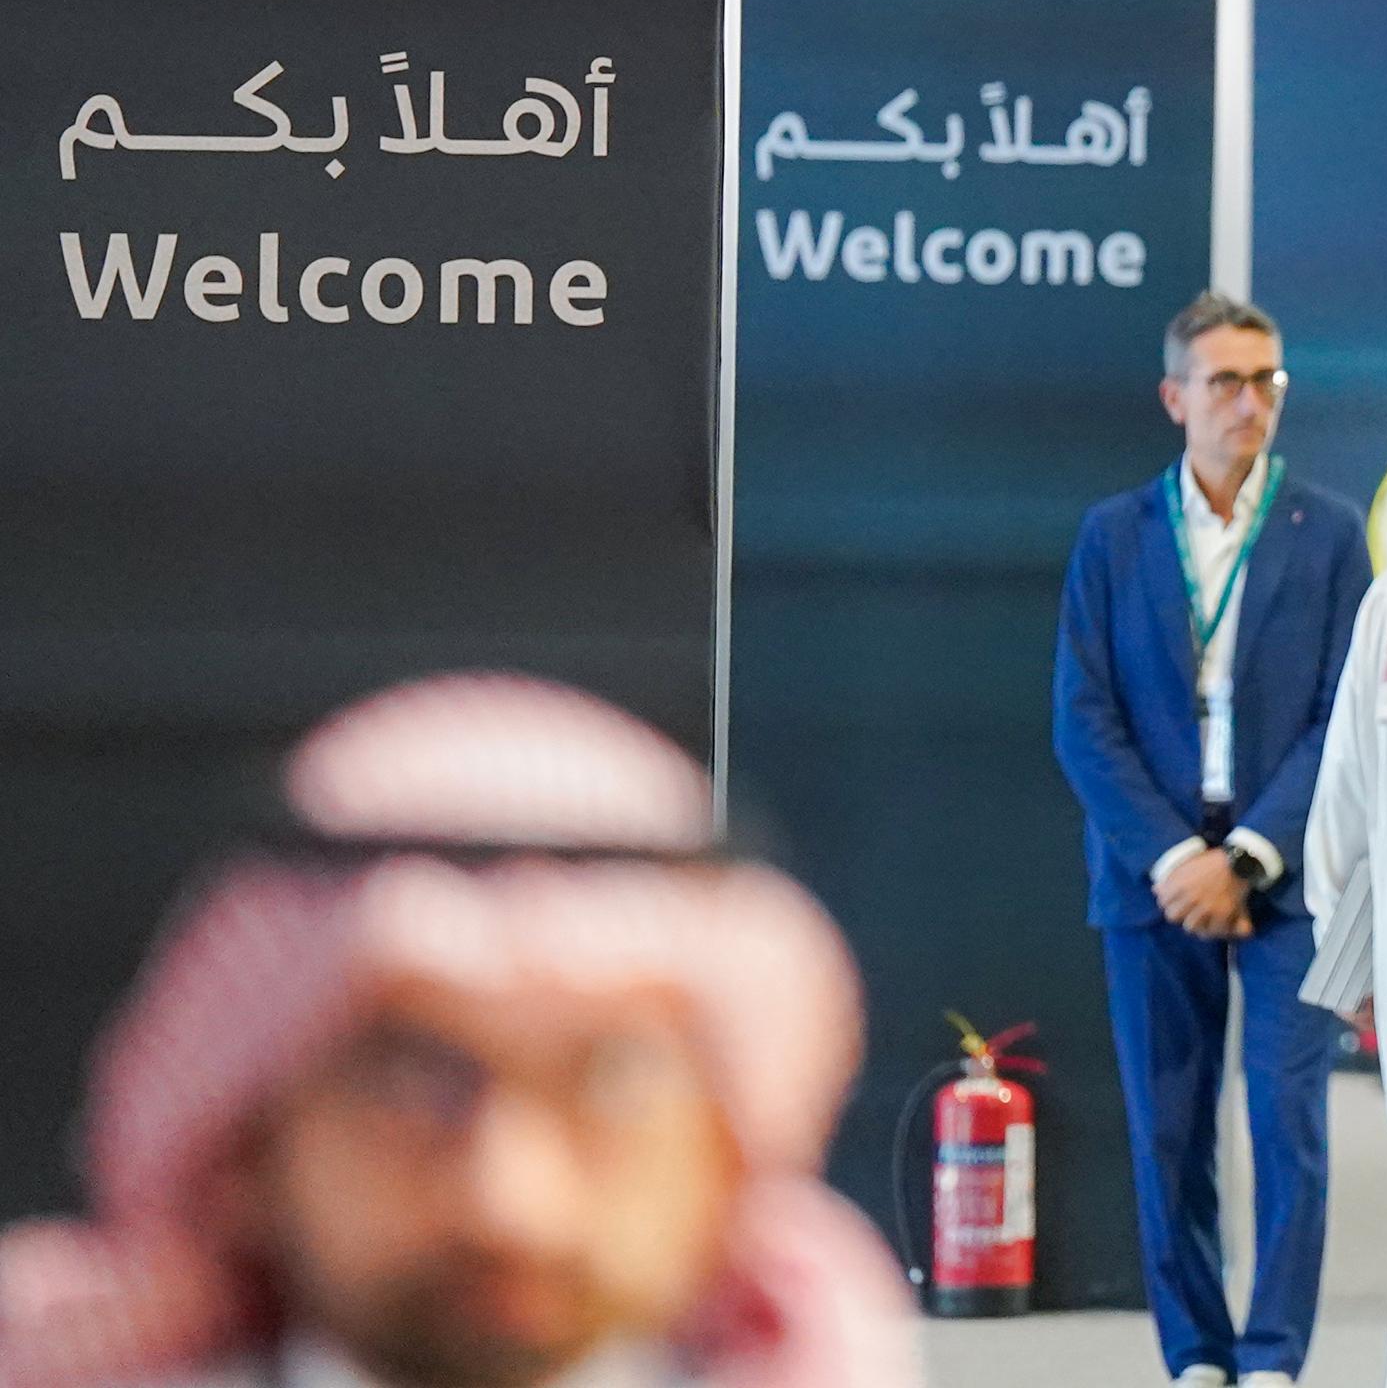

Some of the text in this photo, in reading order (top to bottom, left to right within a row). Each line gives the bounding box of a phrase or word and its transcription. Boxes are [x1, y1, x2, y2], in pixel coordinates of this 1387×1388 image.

[59, 60, 349, 180] بكم
[755, 88, 965, 181] بكم
[59, 232, 608, 327] Welcome
[755, 208, 1146, 287] Welcome
